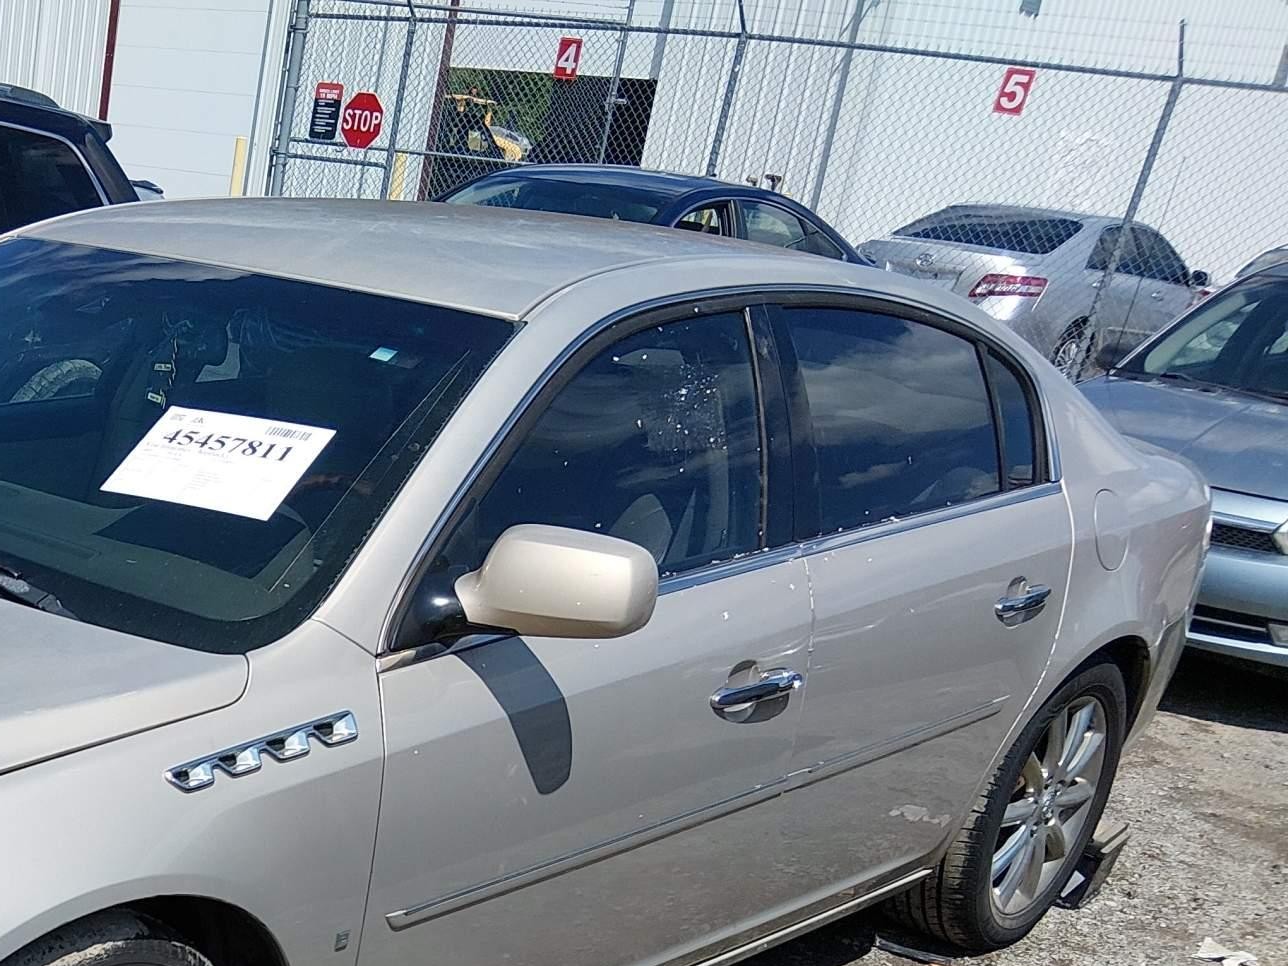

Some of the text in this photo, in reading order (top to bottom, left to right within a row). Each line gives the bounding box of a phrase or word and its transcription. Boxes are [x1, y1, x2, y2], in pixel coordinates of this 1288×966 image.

[558, 43, 577, 74] 4
[1000, 74, 1030, 109] 5
[343, 109, 381, 132] STOP
[163, 429, 294, 462] 45457811
